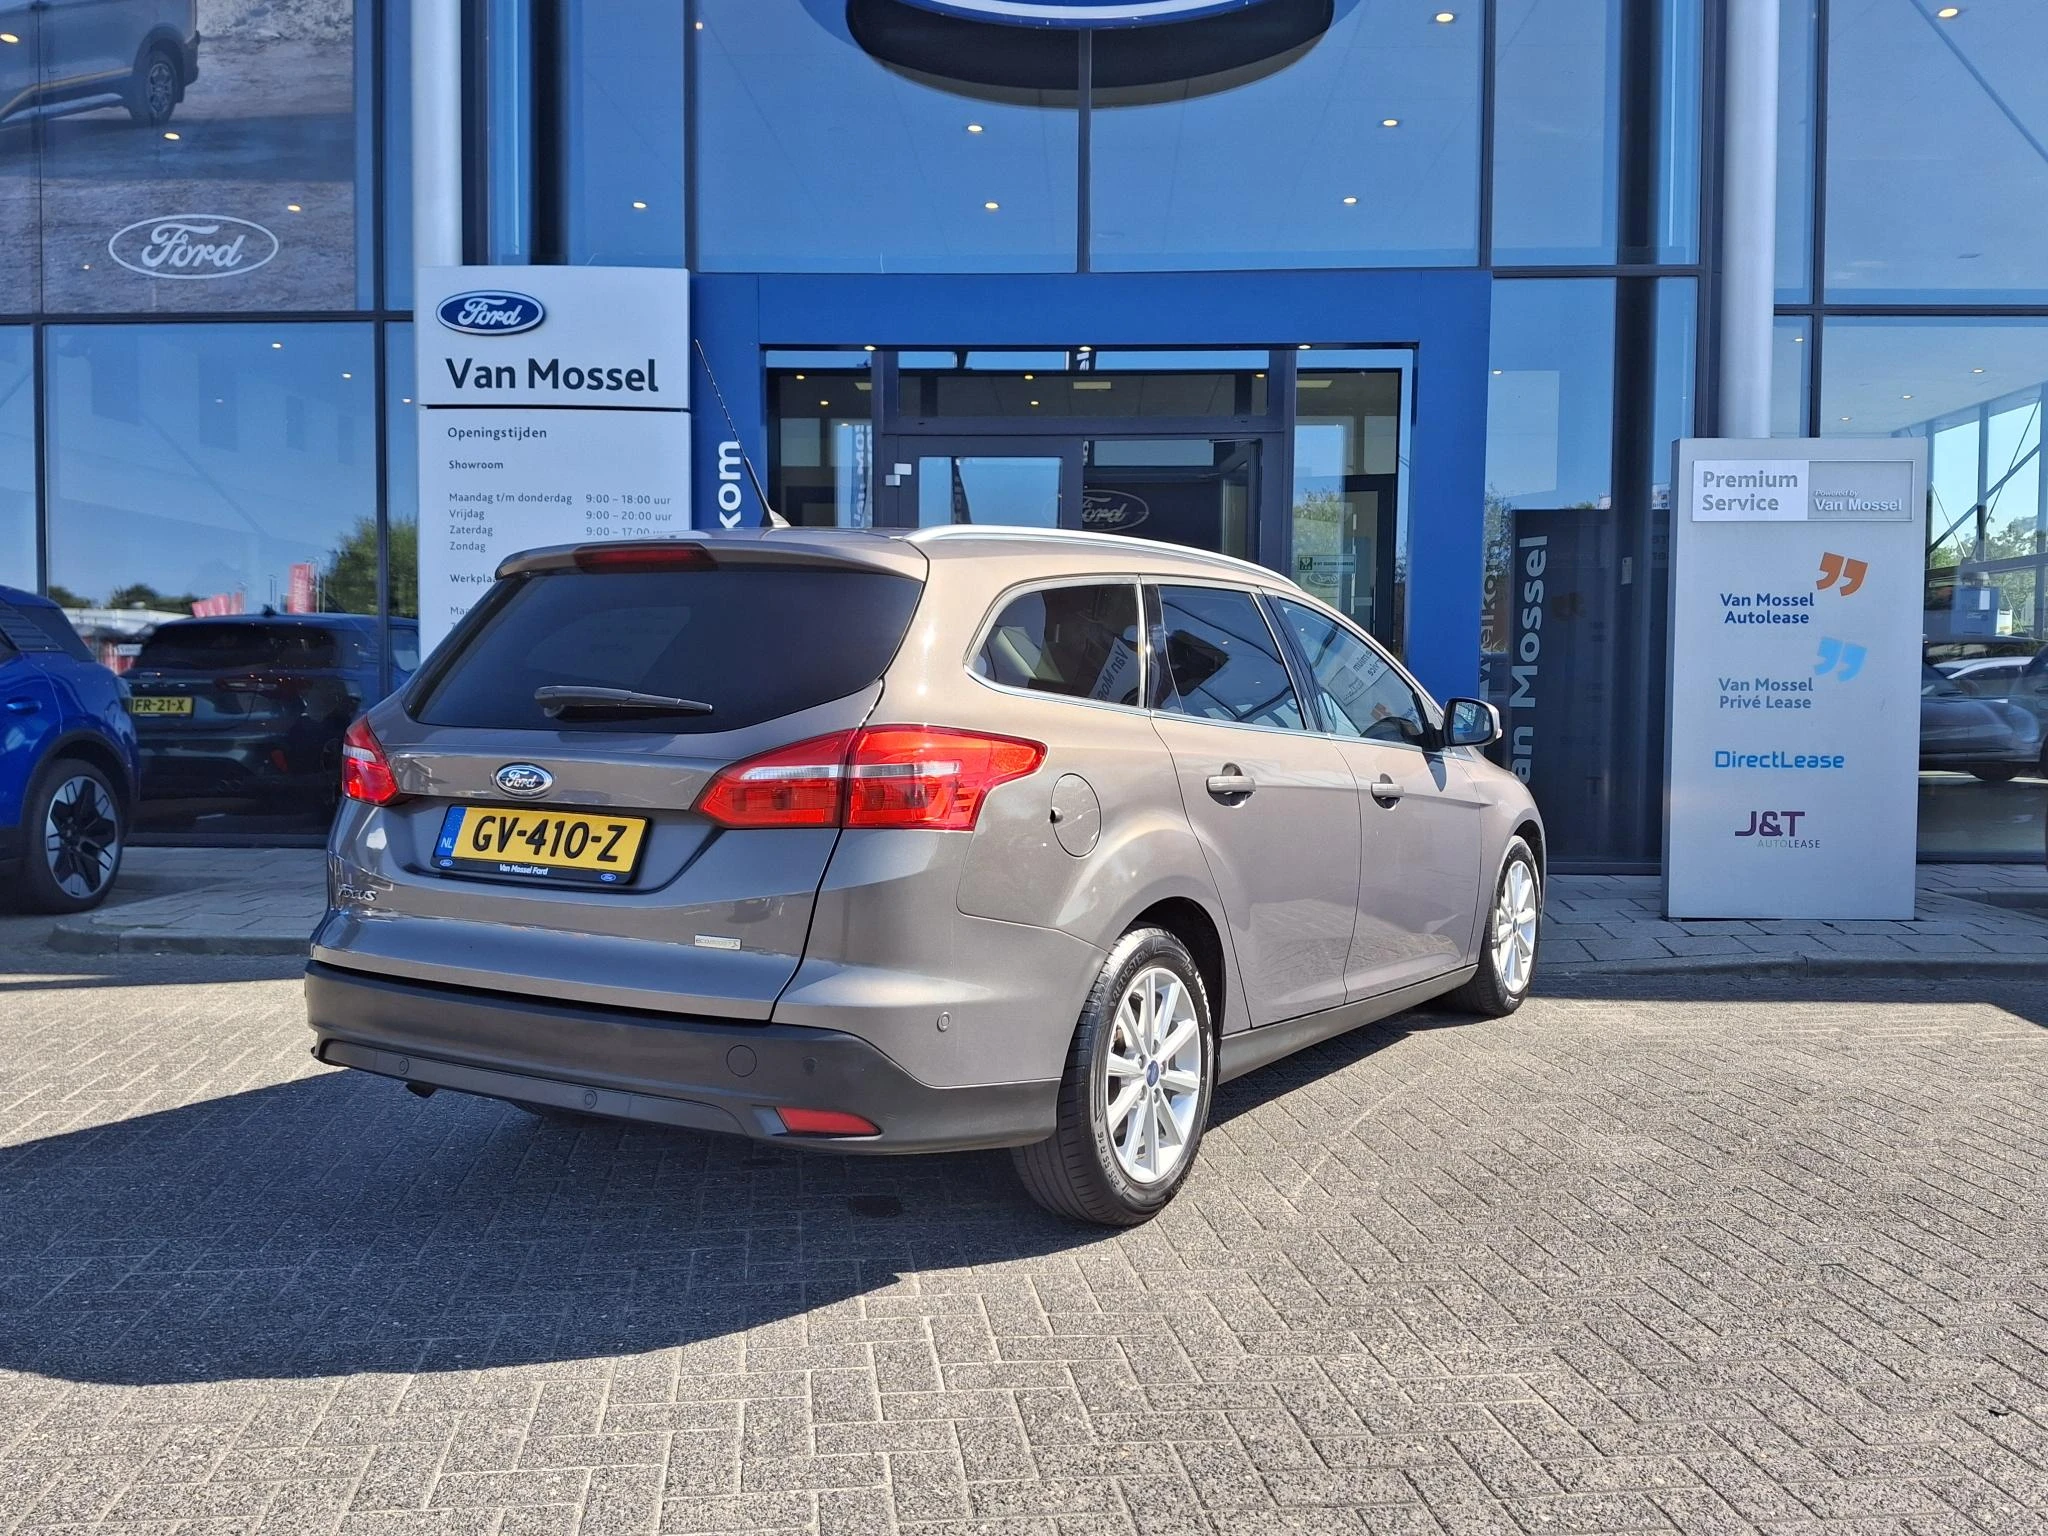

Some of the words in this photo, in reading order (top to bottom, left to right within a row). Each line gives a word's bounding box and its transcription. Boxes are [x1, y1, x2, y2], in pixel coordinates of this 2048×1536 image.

[141, 223, 246, 268] Ford
[457, 297, 522, 325] Ford
[445, 358, 516, 389] Van
[528, 358, 659, 392] Mossel
[448, 426, 547, 441] Openingstijden
[449, 460, 504, 469] Showroom
[1702, 471, 1798, 488] Premium
[449, 493, 493, 505] Maandag
[496, 493, 516, 503] t/m
[518, 494, 572, 506] donderdag
[586, 494, 609, 504] 9:00
[621, 494, 650, 504] 18:00
[653, 497, 671, 505] uur
[1849, 489, 1858, 498] by
[1702, 494, 1779, 511] Service
[1815, 498, 1843, 511] Van
[1847, 498, 1902, 511] Mossel
[449, 509, 485, 521] Vrijdag
[586, 511, 610, 520] 9:00
[621, 511, 651, 521] 20:00
[655, 513, 672, 521] uur
[449, 525, 493, 537] Zaterdag
[586, 527, 610, 536] 9:00
[449, 541, 486, 553] Zondag
[1720, 593, 1751, 606] Van
[1756, 592, 1814, 607] Mossel
[1509, 535, 1549, 708] Mossel
[1724, 610, 1809, 624] Autolease
[1718, 678, 1750, 691] Van
[1755, 677, 1813, 692] Mossel
[1719, 695, 1761, 709] Privé
[1766, 695, 1812, 709] Lease
[1715, 751, 1845, 768] DirectLease
[1735, 811, 1806, 837] J&T
[441, 837, 453, 849] NL
[472, 815, 628, 863] GV-410-Z
[1758, 840, 1821, 849] AUTOLEASE
[532, 866, 549, 876] Ford
